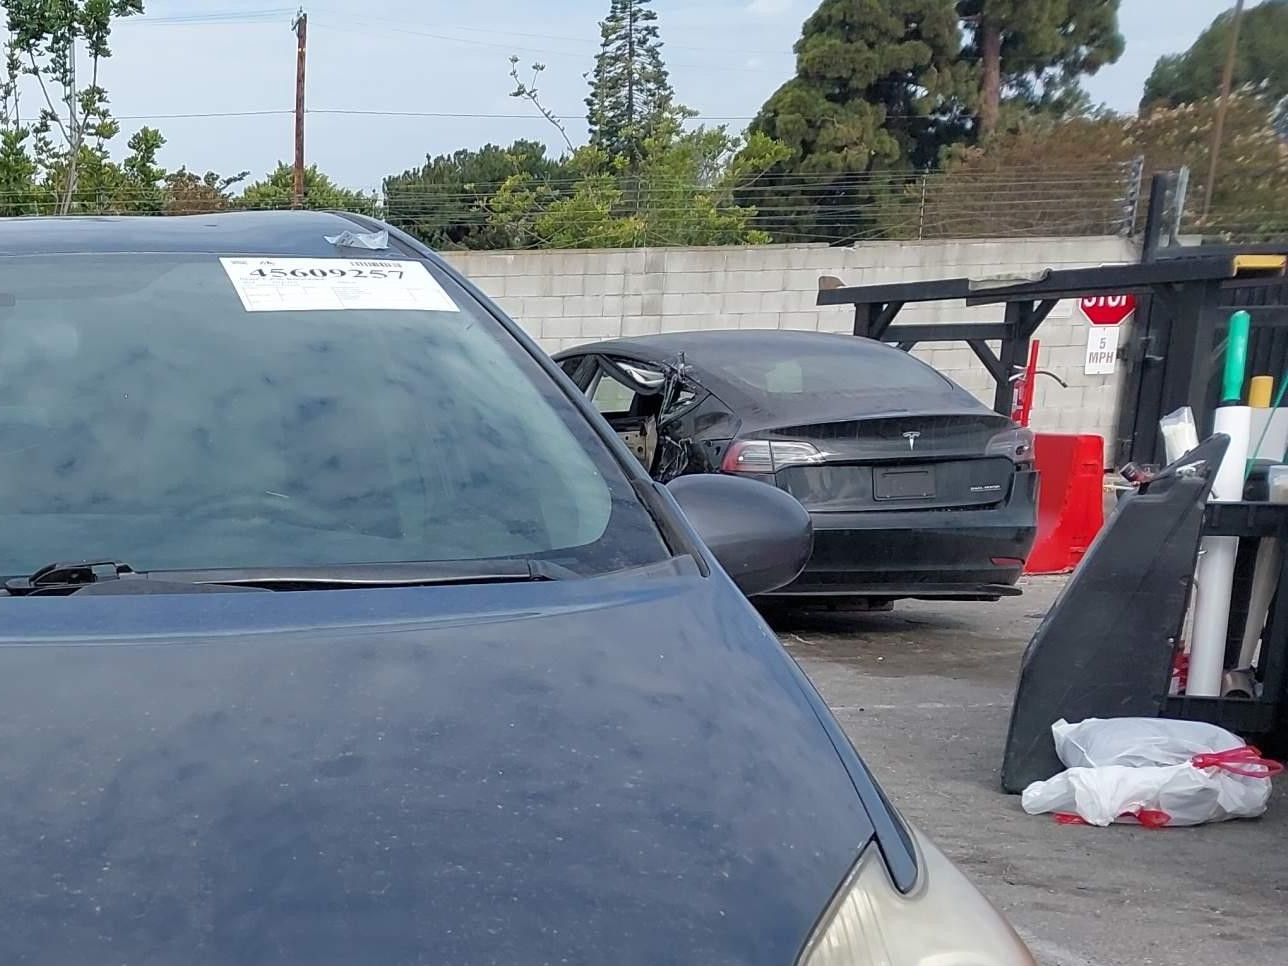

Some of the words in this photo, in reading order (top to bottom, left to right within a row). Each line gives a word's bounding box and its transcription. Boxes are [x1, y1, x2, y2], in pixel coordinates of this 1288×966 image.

[249, 268, 405, 280] 45609257
[1099, 337, 1107, 350] 5
[1088, 351, 1114, 364] MPH
